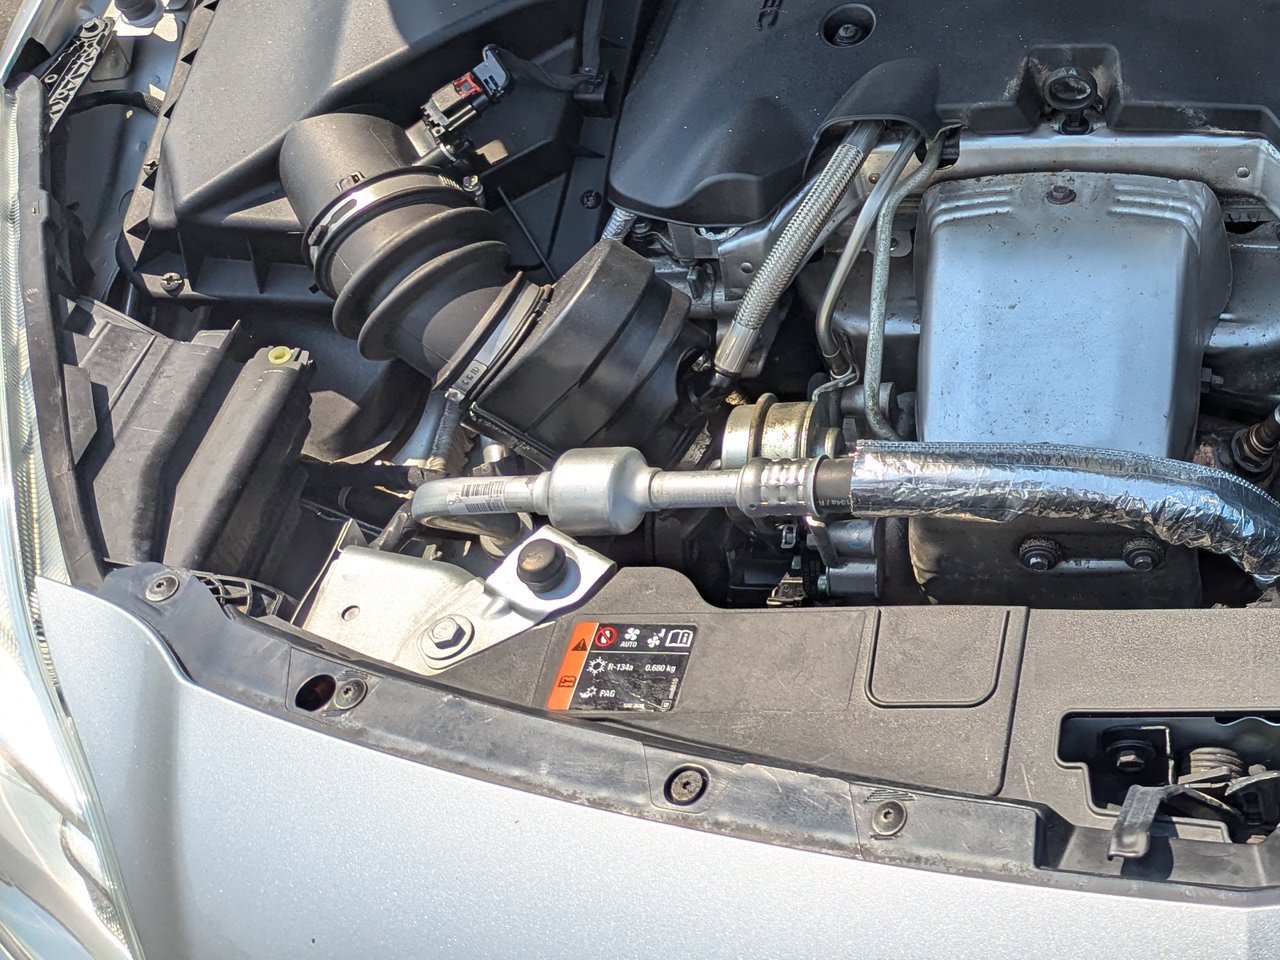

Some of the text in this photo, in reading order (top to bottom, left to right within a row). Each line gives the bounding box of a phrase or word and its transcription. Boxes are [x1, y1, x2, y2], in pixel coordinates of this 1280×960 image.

[607, 664, 677, 673] R-134a 0.680 kg
[599, 689, 616, 698] PAG
